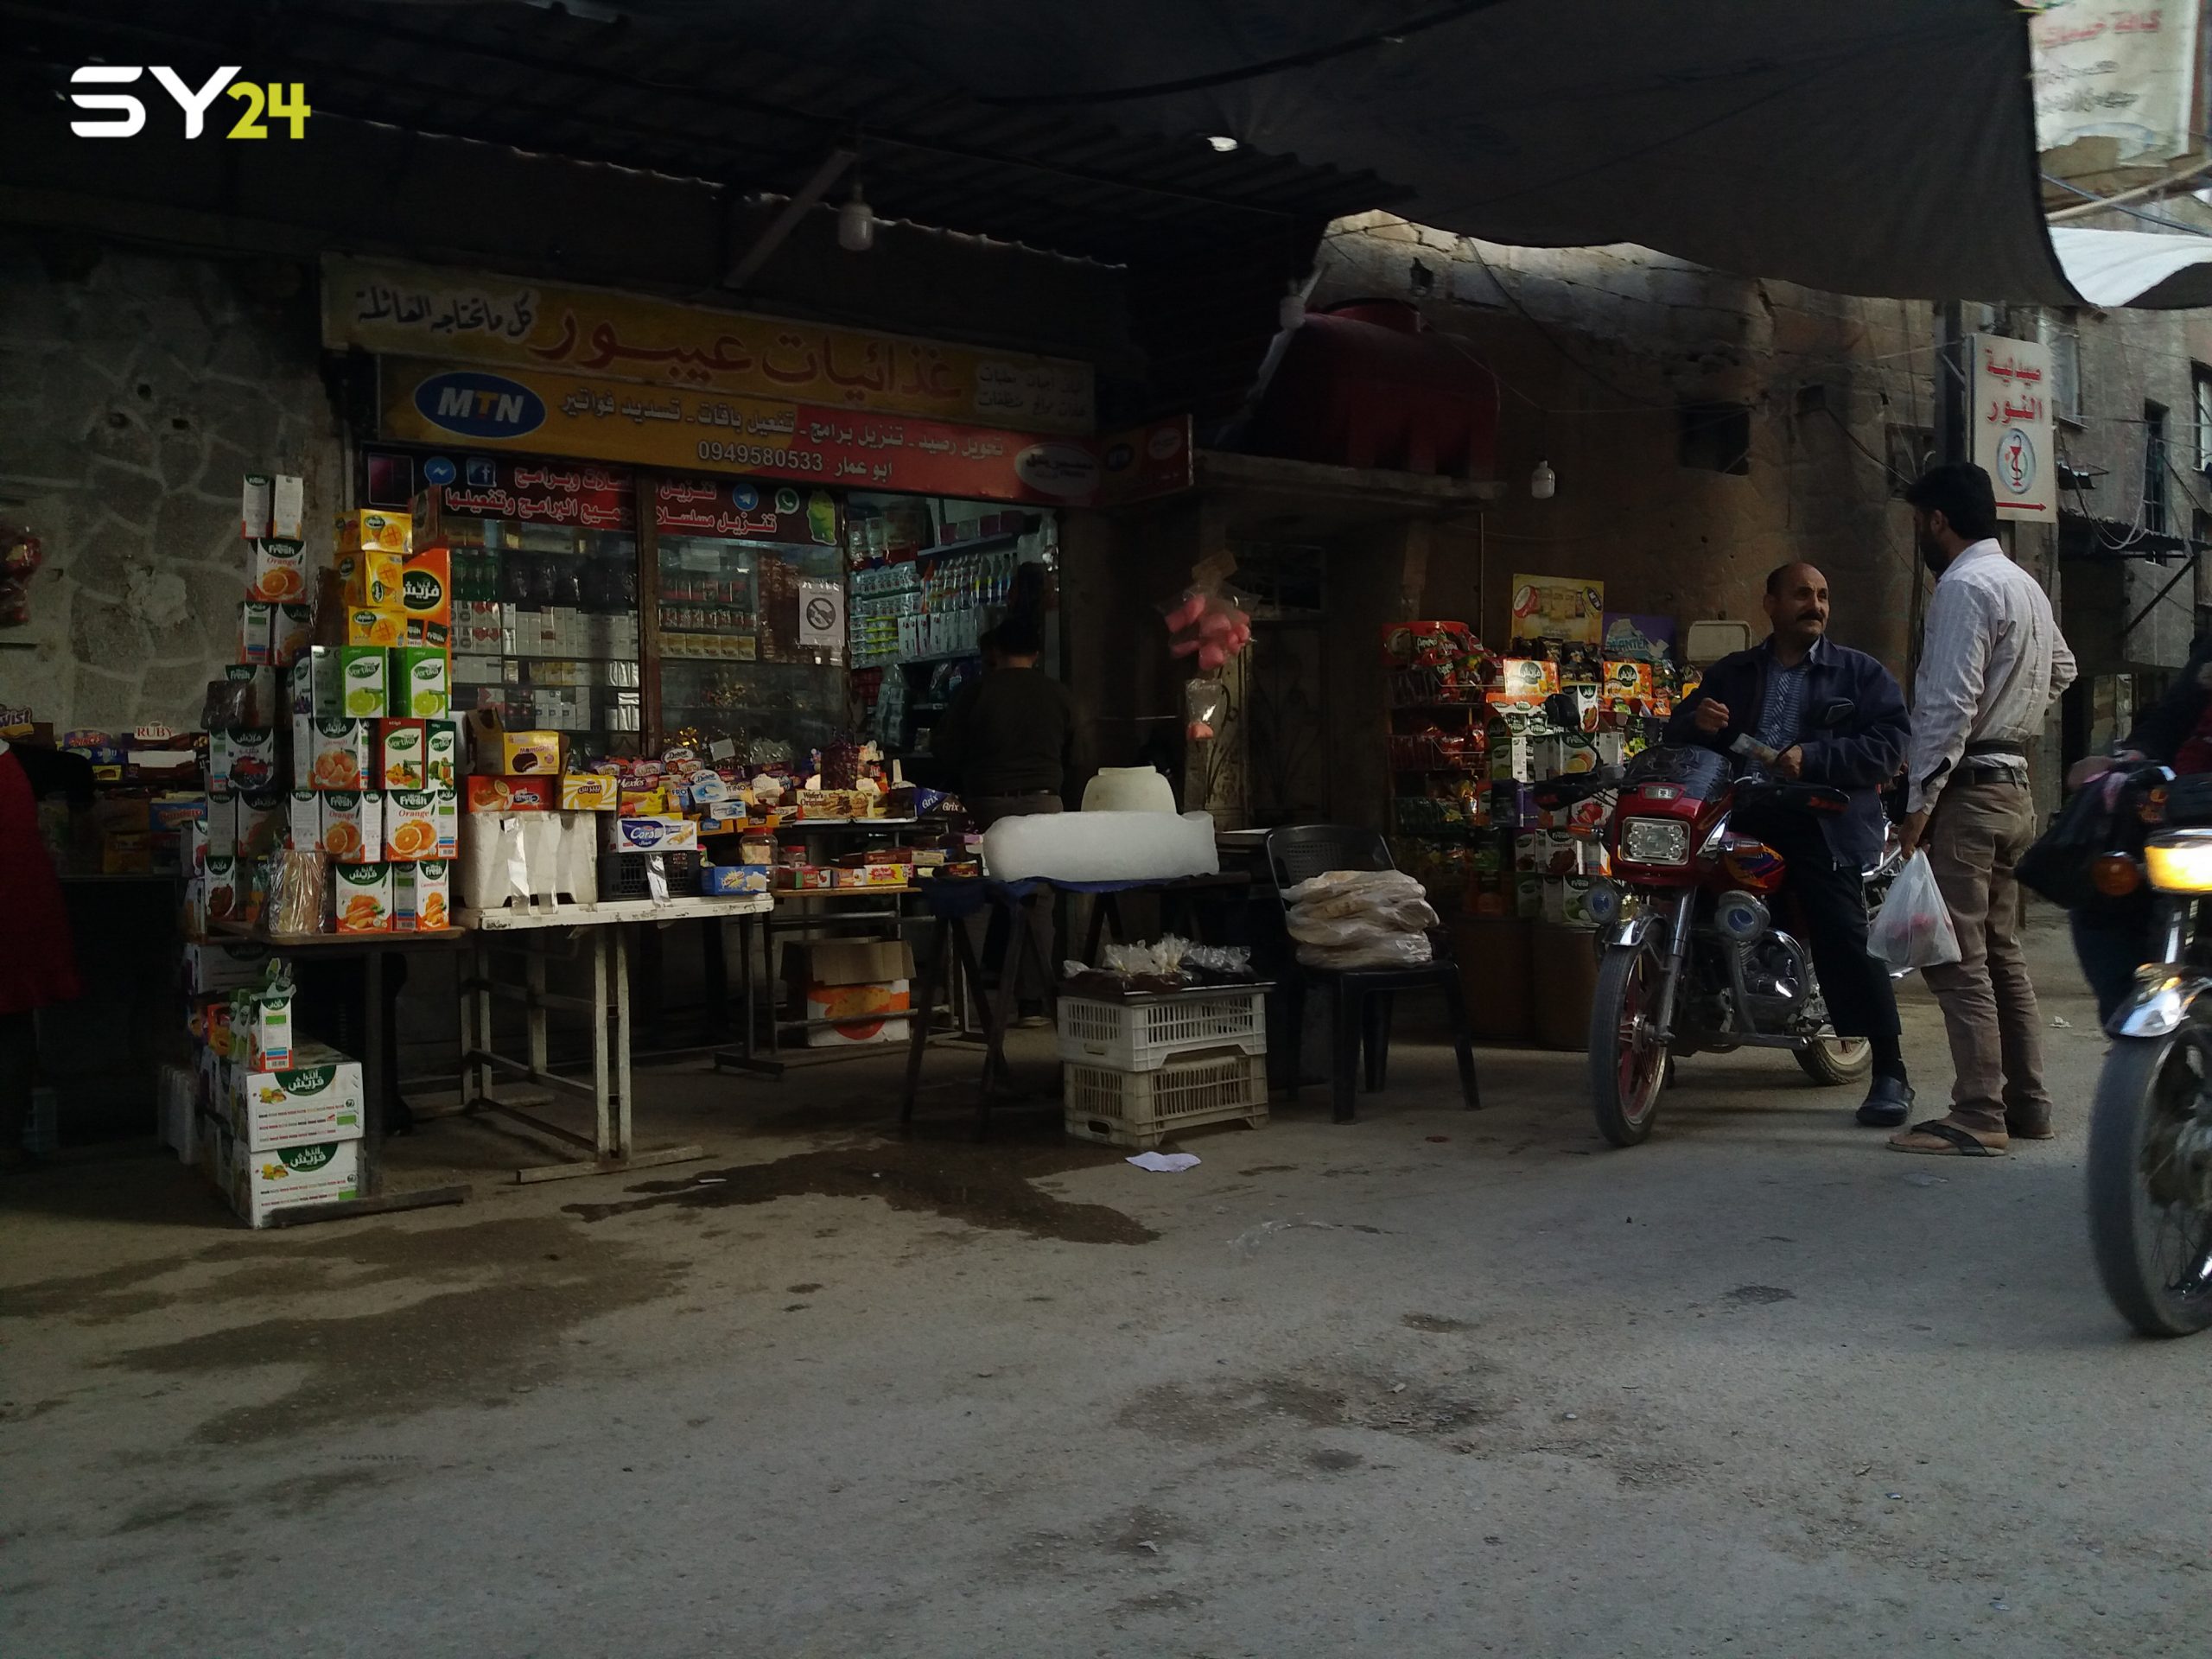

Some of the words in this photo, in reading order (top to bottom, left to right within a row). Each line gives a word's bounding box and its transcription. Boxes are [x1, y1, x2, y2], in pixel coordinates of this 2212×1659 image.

[763, 334, 962, 399] غذائيات
[1985, 348, 2042, 386] صيدلية
[437, 387, 524, 424] MTN
[562, 388, 615, 417] فواتير
[620, 397, 681, 423] تسديد
[1987, 394, 2043, 424] النور
[697, 402, 742, 433] باقات
[747, 410, 795, 436] تفعيل
[810, 422, 854, 446] برامج
[857, 423, 904, 448] تنزيل
[918, 435, 957, 455] رصيد
[698, 441, 823, 472] 0949580533
[961, 436, 1004, 460] تحويل
[835, 455, 867, 476] عمار
[872, 460, 893, 483] ابو
[445, 486, 516, 517] وتفعيلها
[518, 496, 578, 522] البرامج
[716, 511, 778, 536] تنزيل
[137, 727, 171, 737] RUBY
[400, 794, 428, 806] Fresh
[942, 801, 960, 812] Grix
[399, 810, 429, 819] Orange
[288, 1077, 325, 1092] فريش
[289, 1152, 327, 1168] فريش
